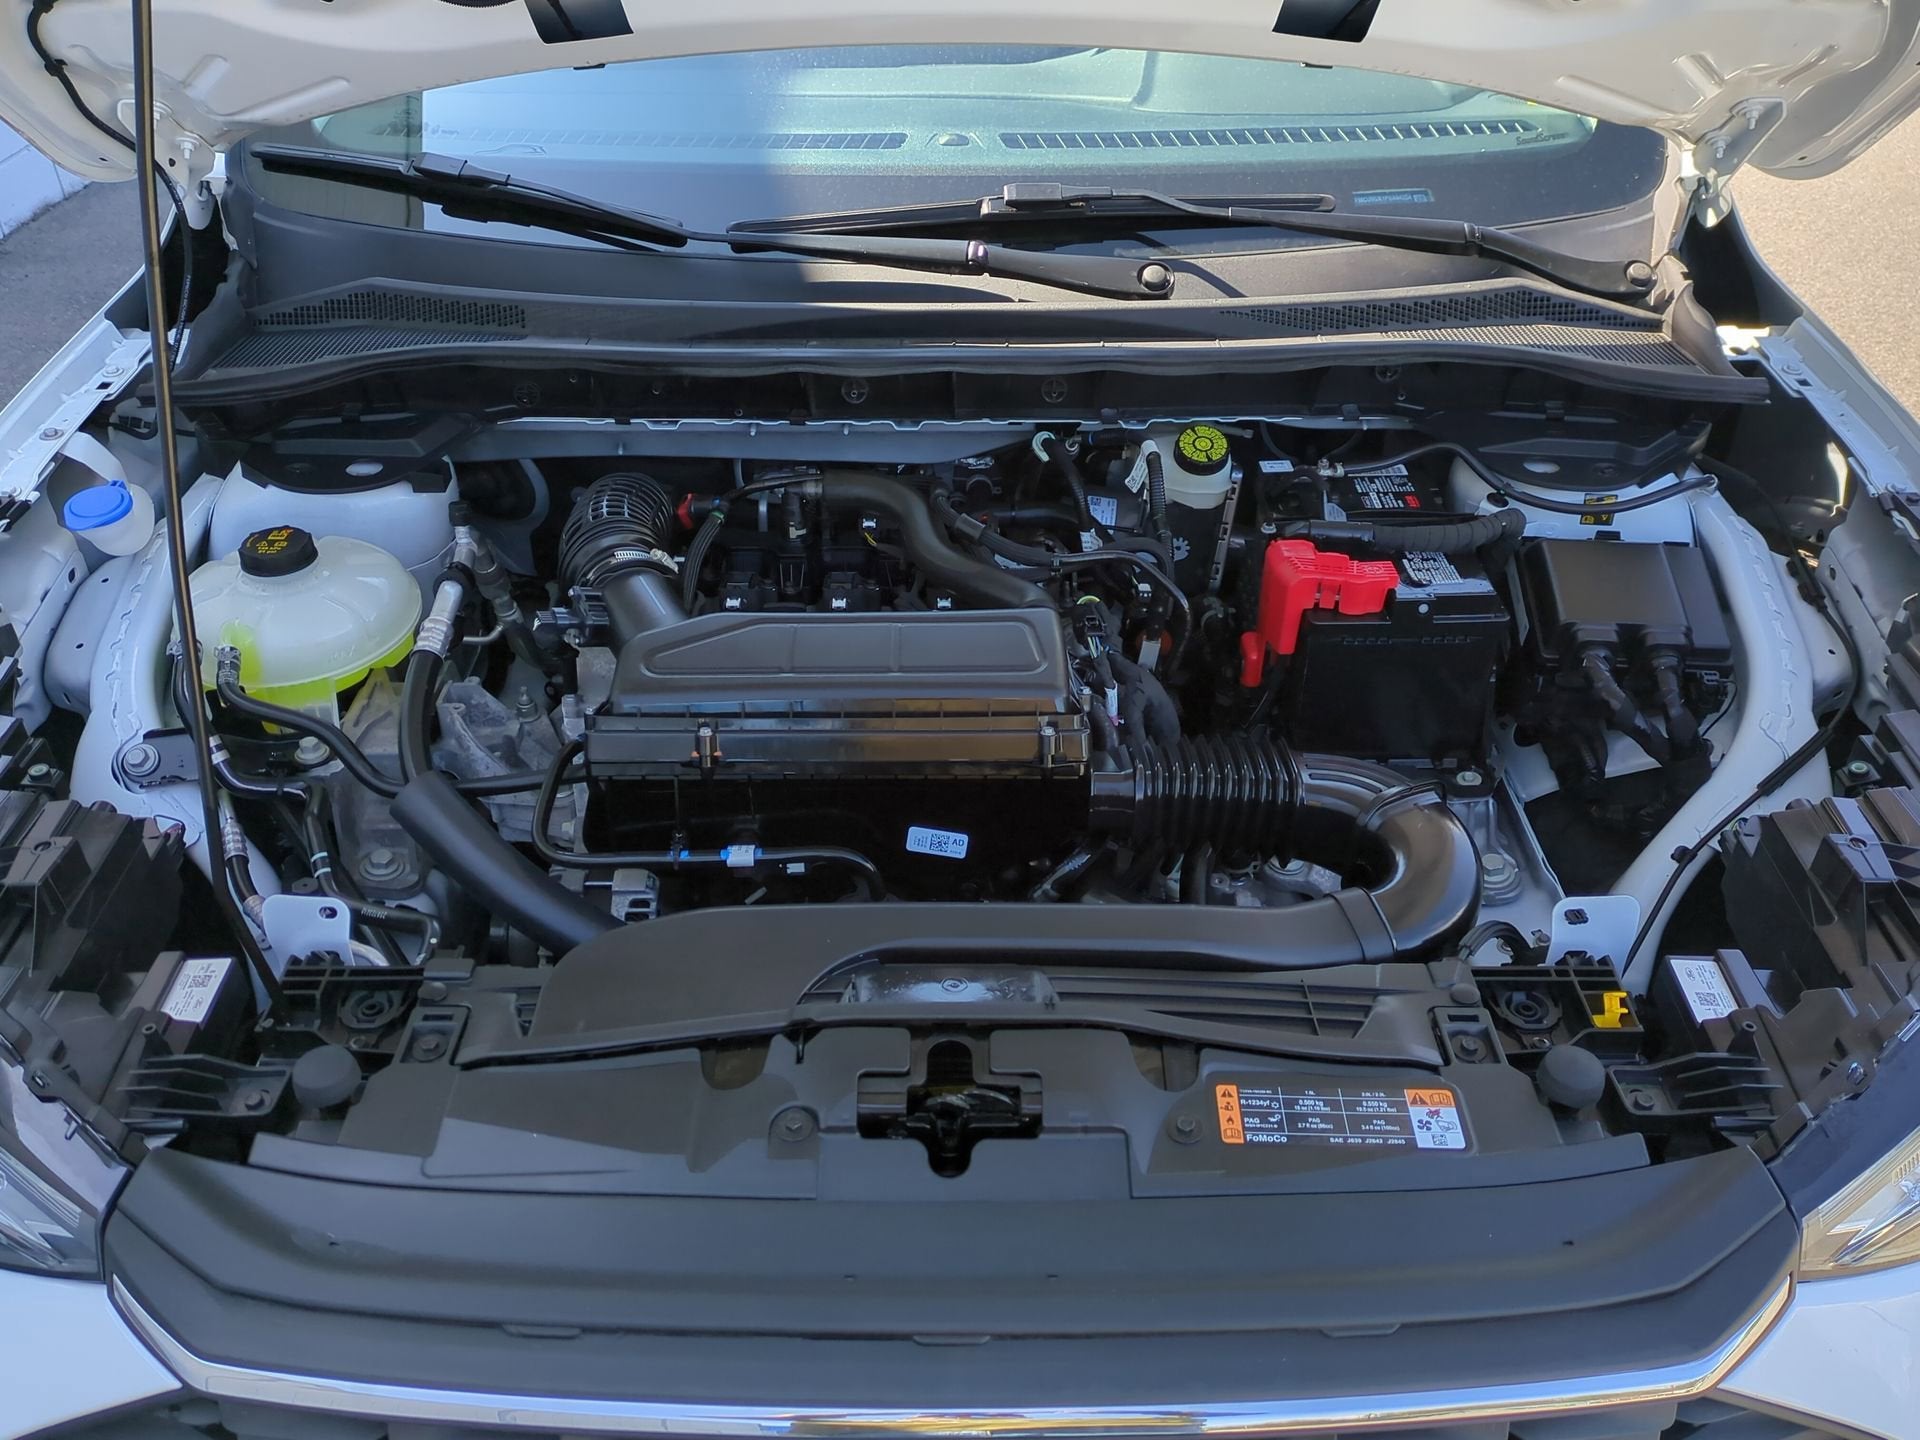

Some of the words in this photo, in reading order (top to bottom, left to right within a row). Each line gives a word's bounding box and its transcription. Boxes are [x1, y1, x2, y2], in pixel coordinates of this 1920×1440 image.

[952, 838, 965, 847] AD
[1240, 1099, 1270, 1107] R-1234yf
[1246, 1133, 1288, 1143] FoMoCo
